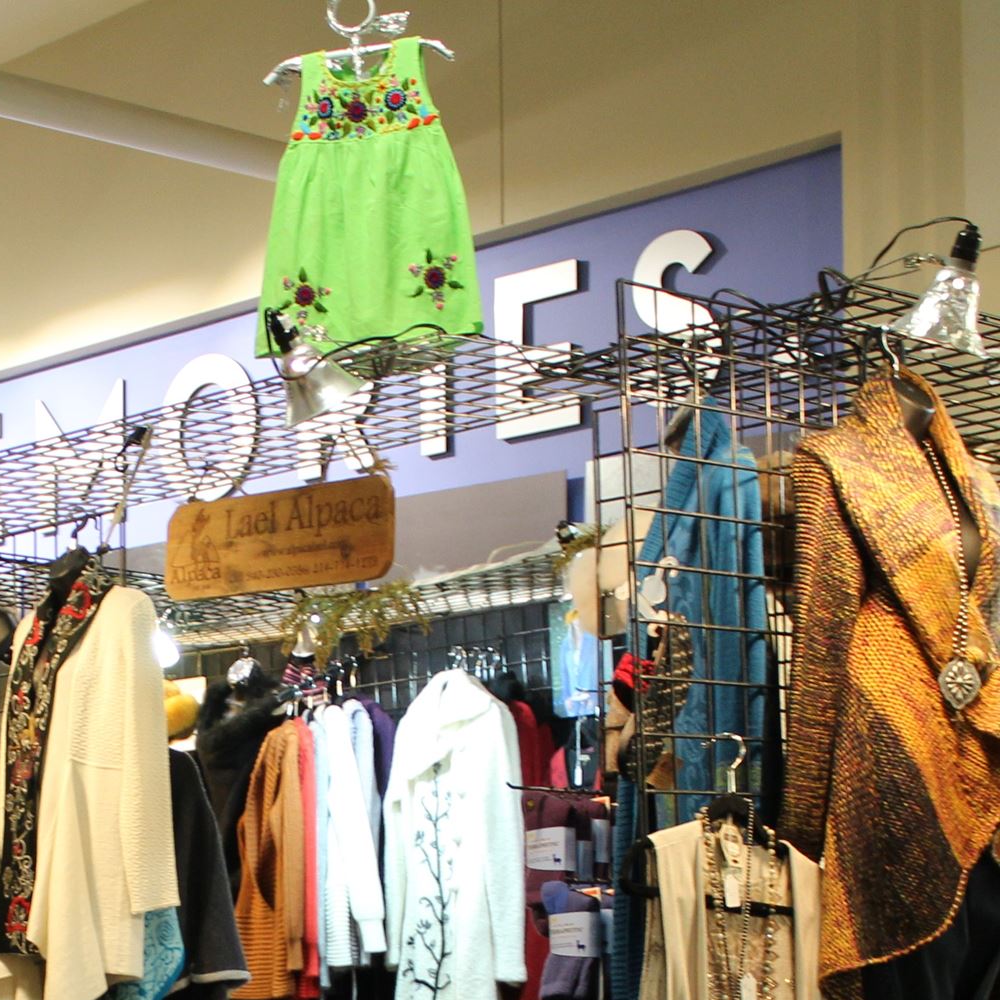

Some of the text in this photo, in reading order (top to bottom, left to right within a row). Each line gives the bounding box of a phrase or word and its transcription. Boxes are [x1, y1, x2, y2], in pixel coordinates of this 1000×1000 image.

[225, 493, 384, 540] Lael Alpaca
[170, 564, 221, 585] Alpaca
